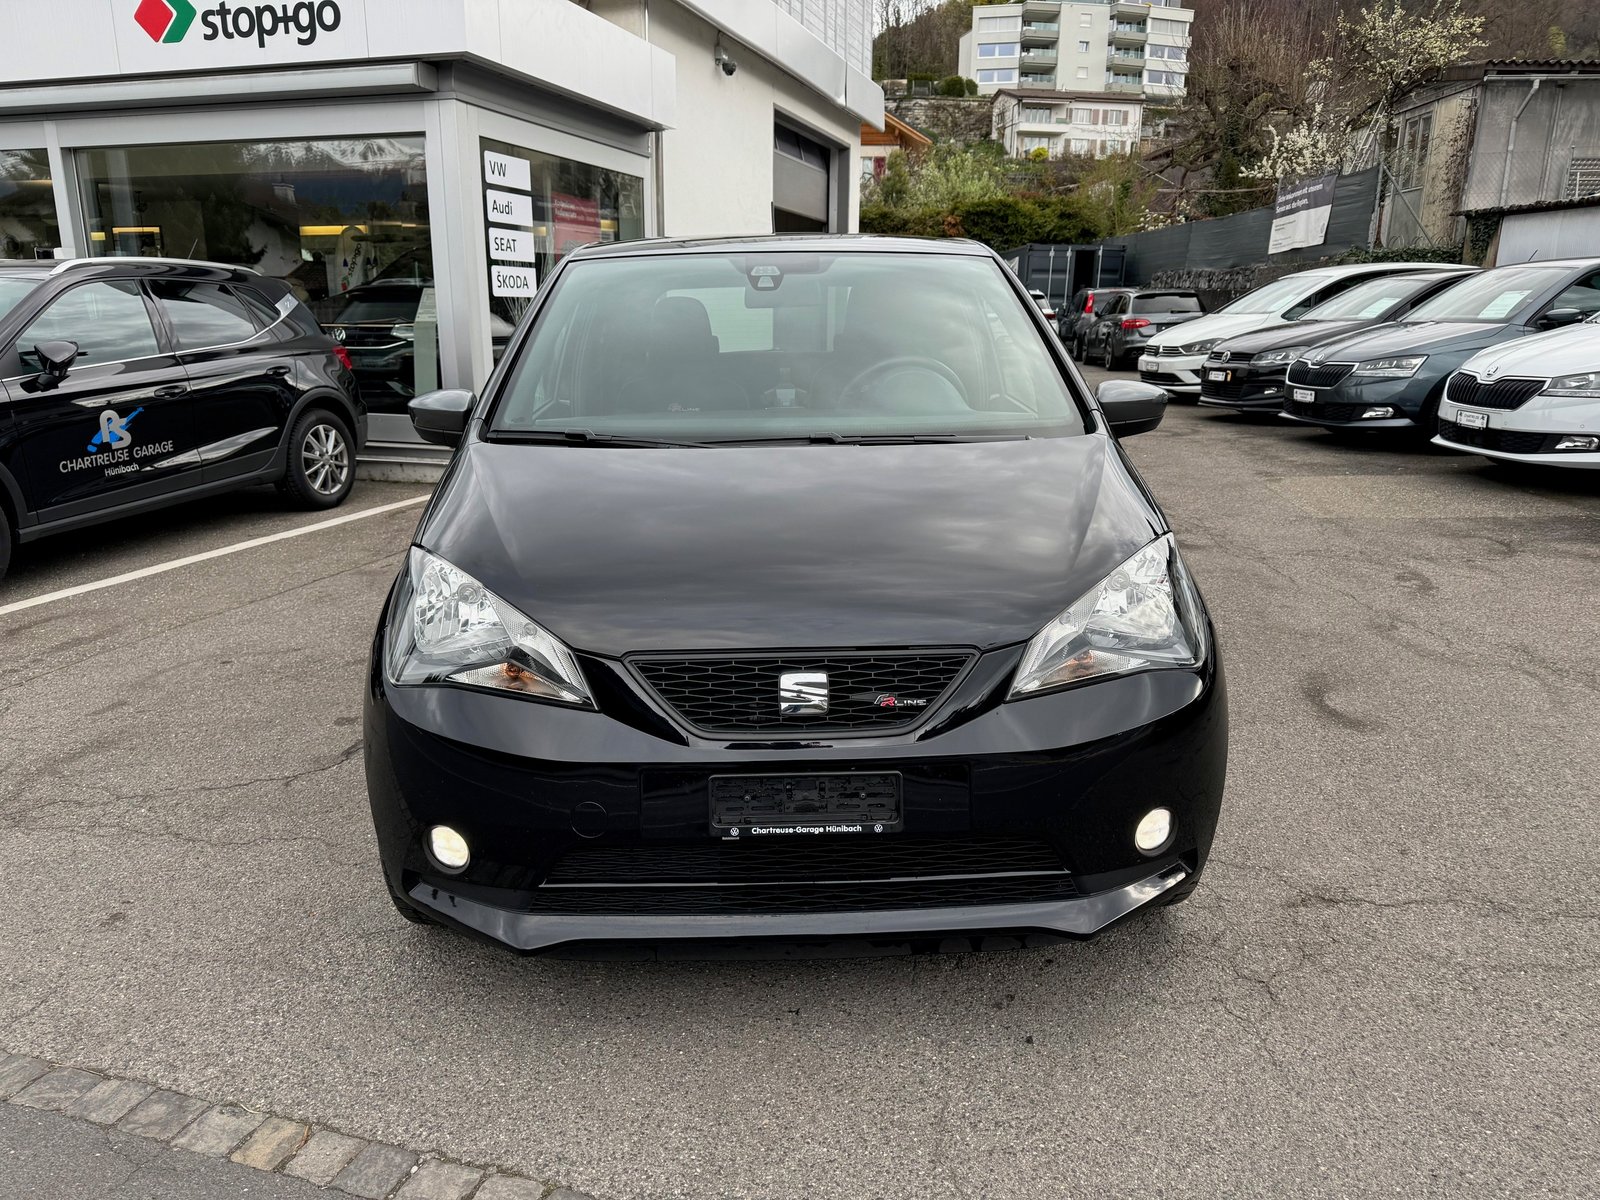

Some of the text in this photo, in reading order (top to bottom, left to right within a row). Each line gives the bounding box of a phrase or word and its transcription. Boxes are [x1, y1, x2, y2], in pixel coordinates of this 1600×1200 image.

[201, 0, 341, 48] stop+go
[489, 160, 507, 177] VW
[492, 199, 513, 215] Audi
[494, 236, 517, 252] SEAT
[496, 271, 529, 289] ŠKODA
[59, 440, 174, 473] CHARTREUSE GARAGE
[104, 463, 140, 477] Hünibach
[751, 825, 862, 834] Chartreuse-Garage Hünibach
